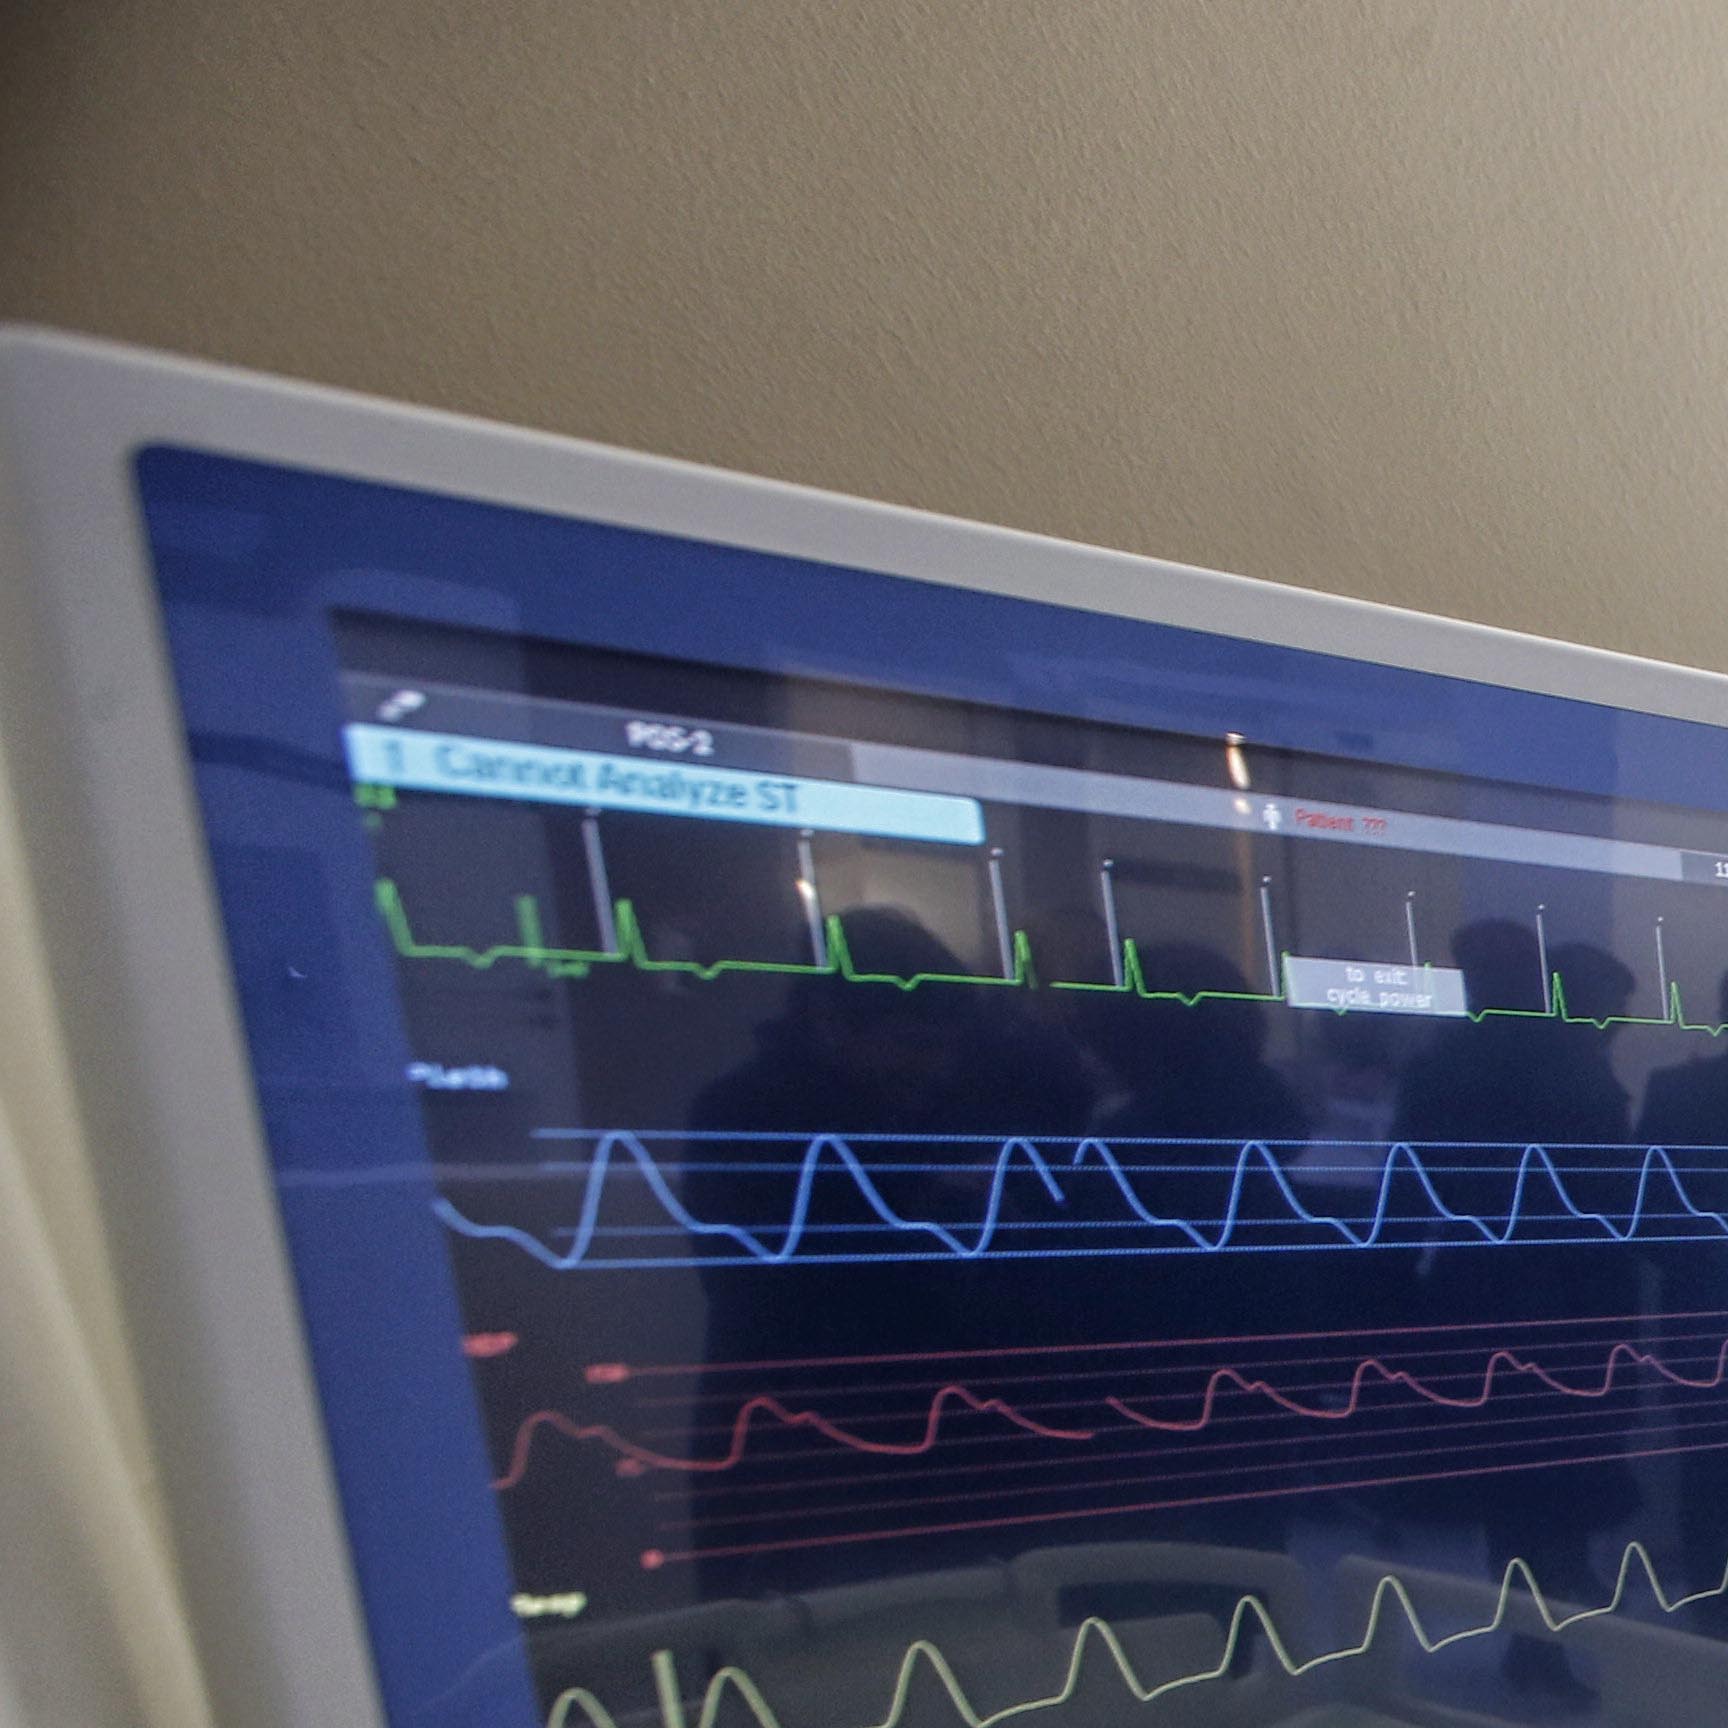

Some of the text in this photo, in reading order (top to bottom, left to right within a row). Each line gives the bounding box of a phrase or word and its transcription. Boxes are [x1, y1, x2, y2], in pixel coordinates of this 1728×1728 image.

[433, 744, 588, 792] Cannot
[598, 762, 749, 808] Analyze
[757, 781, 799, 813] ST
[1295, 808, 1354, 831] Patient
[1346, 966, 1408, 985] to exit
[1327, 987, 1433, 1009] cycle power
